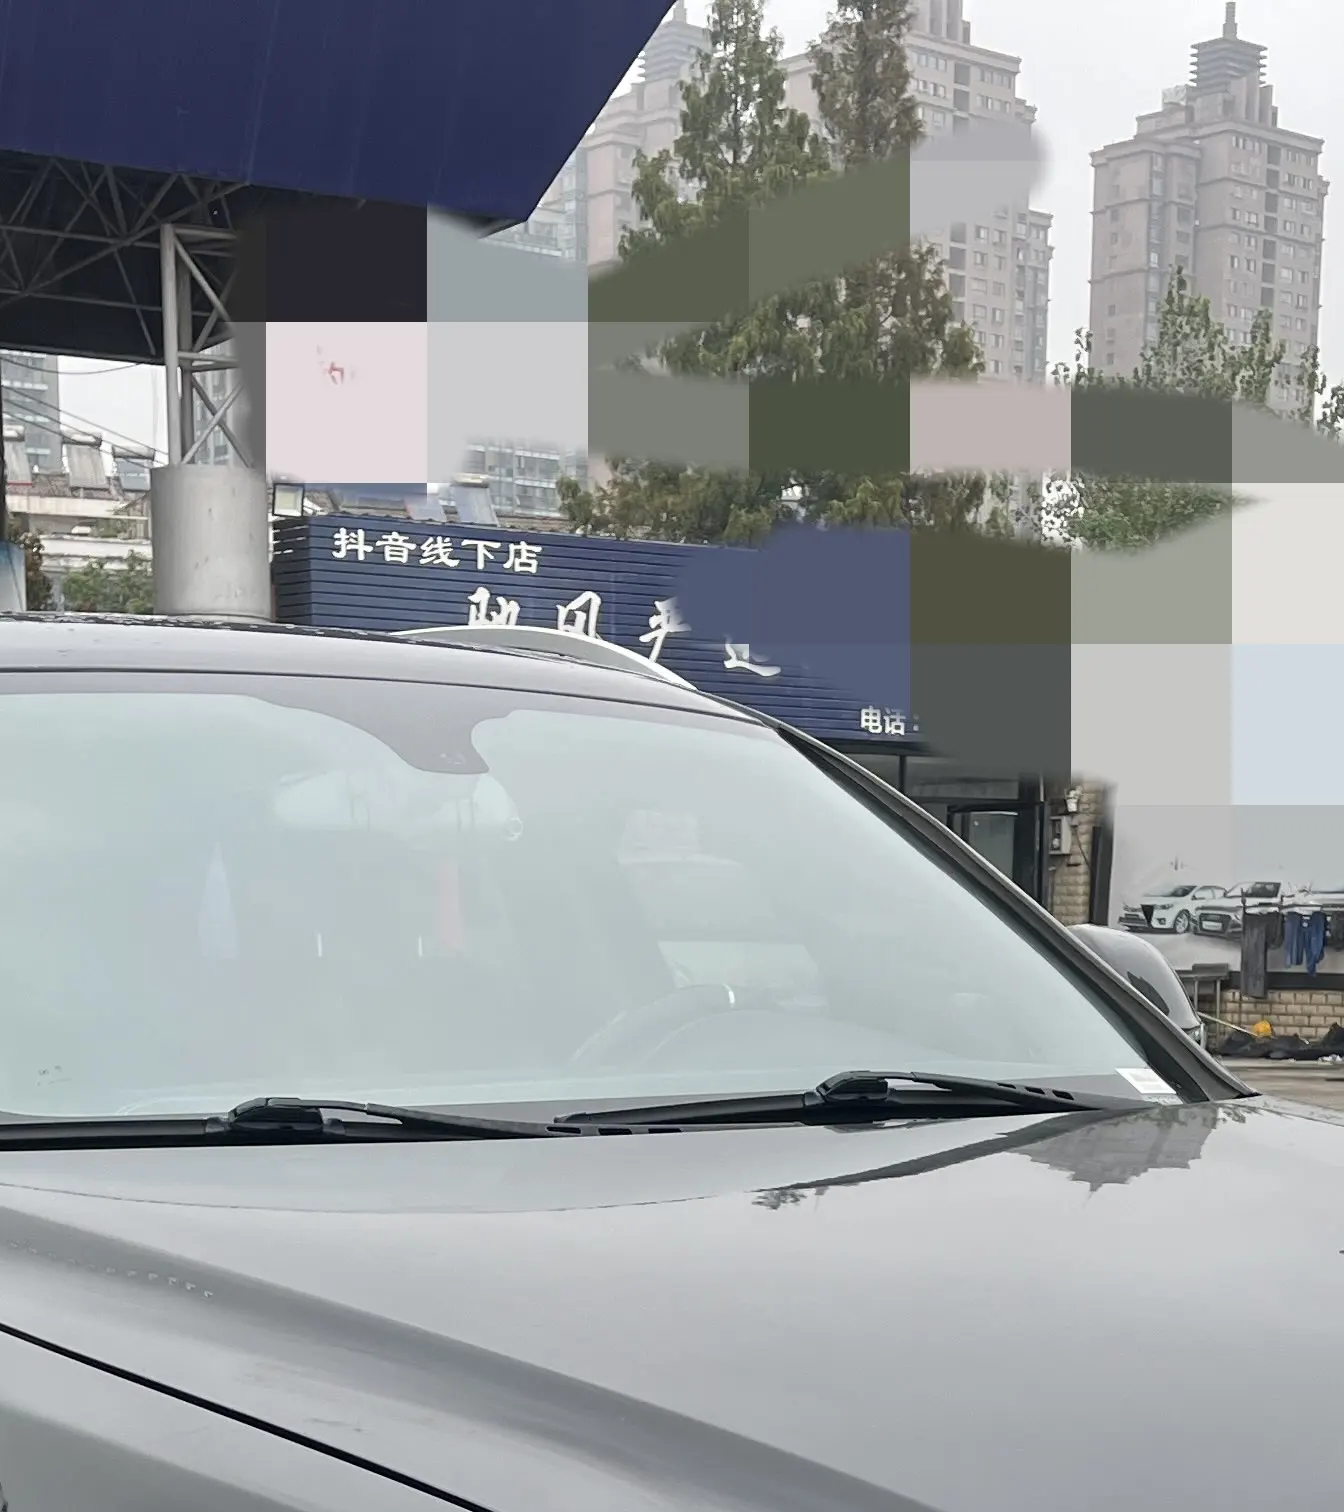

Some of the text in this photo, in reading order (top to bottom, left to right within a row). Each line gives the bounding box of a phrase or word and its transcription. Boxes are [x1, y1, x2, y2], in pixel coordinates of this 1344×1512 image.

[332, 527, 543, 573] 抖音线下店
